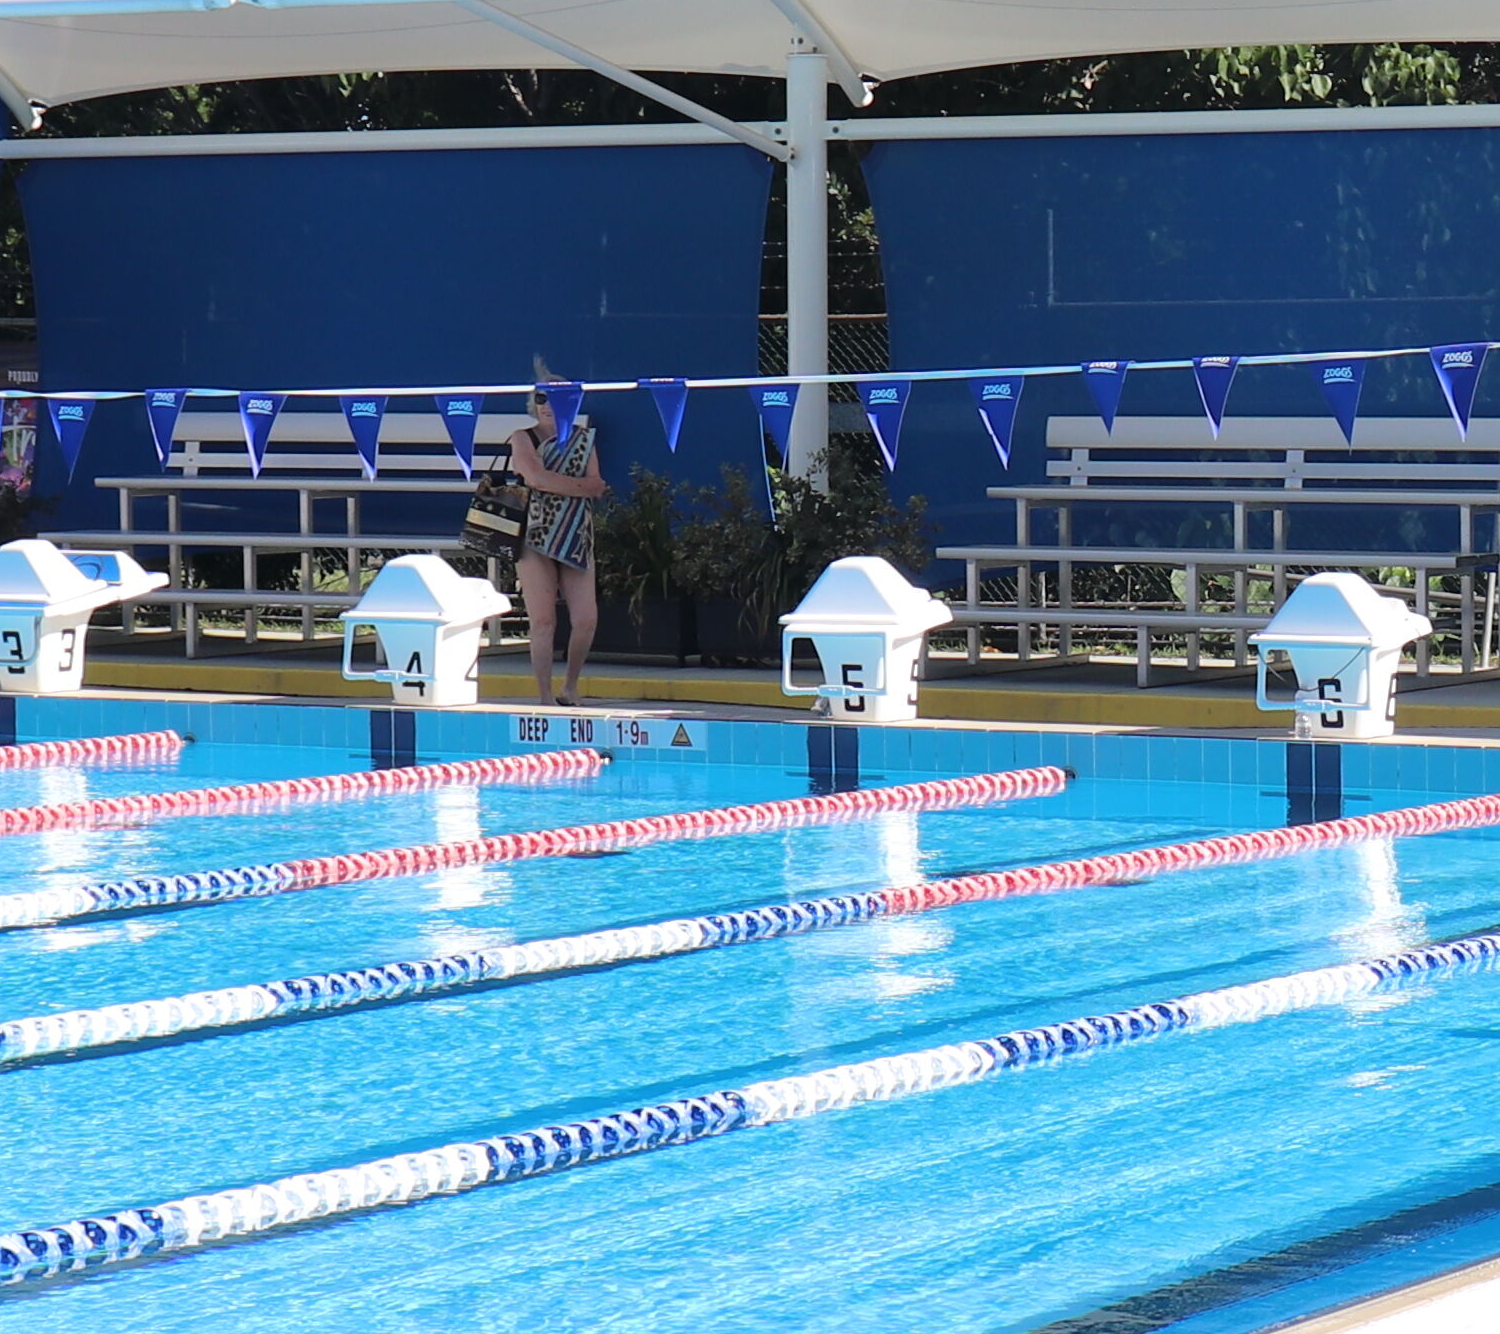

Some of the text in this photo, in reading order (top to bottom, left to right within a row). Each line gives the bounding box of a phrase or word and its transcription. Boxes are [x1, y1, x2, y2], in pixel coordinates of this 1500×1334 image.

[2, 631, 25, 674] 3
[59, 629, 76, 672] 3
[403, 651, 425, 697] 4
[841, 664, 865, 712] 5
[1318, 679, 1344, 728] 6
[519, 716, 549, 742] DEEP
[571, 719, 593, 743] END
